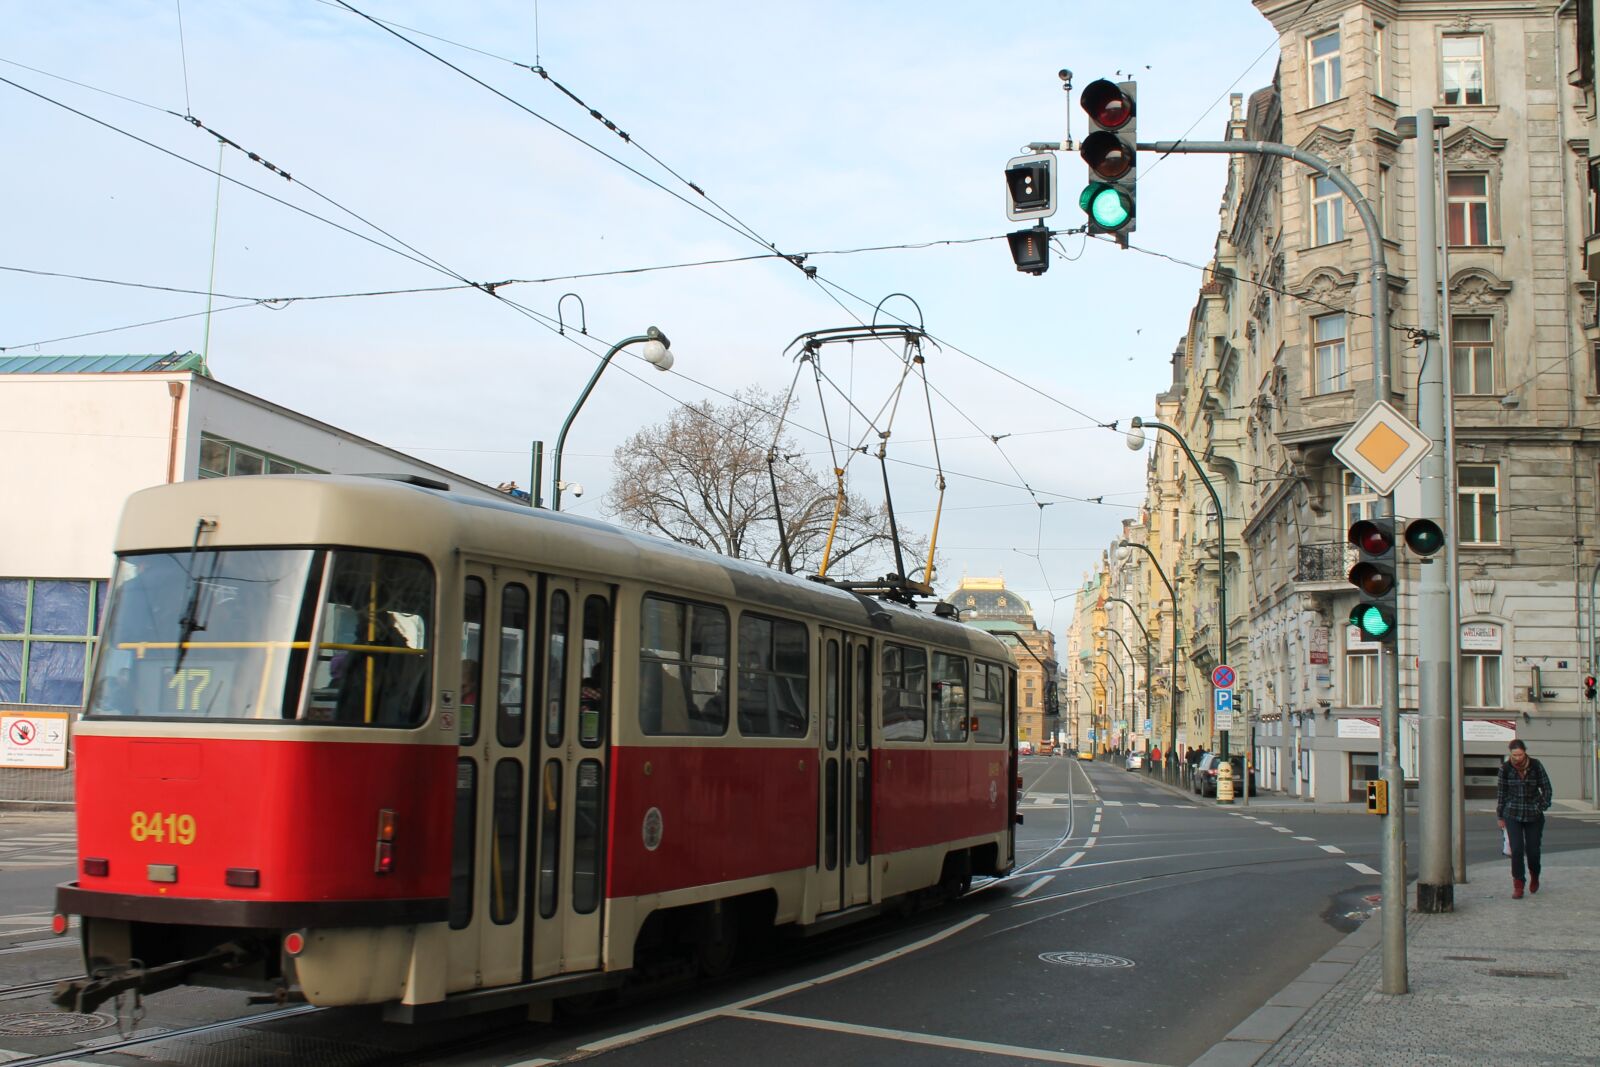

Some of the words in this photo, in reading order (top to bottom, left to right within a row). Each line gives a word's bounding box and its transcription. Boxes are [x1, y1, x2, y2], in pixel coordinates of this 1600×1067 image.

[167, 669, 210, 710] 17
[1218, 692, 1229, 706] P
[131, 811, 196, 845] 8419
